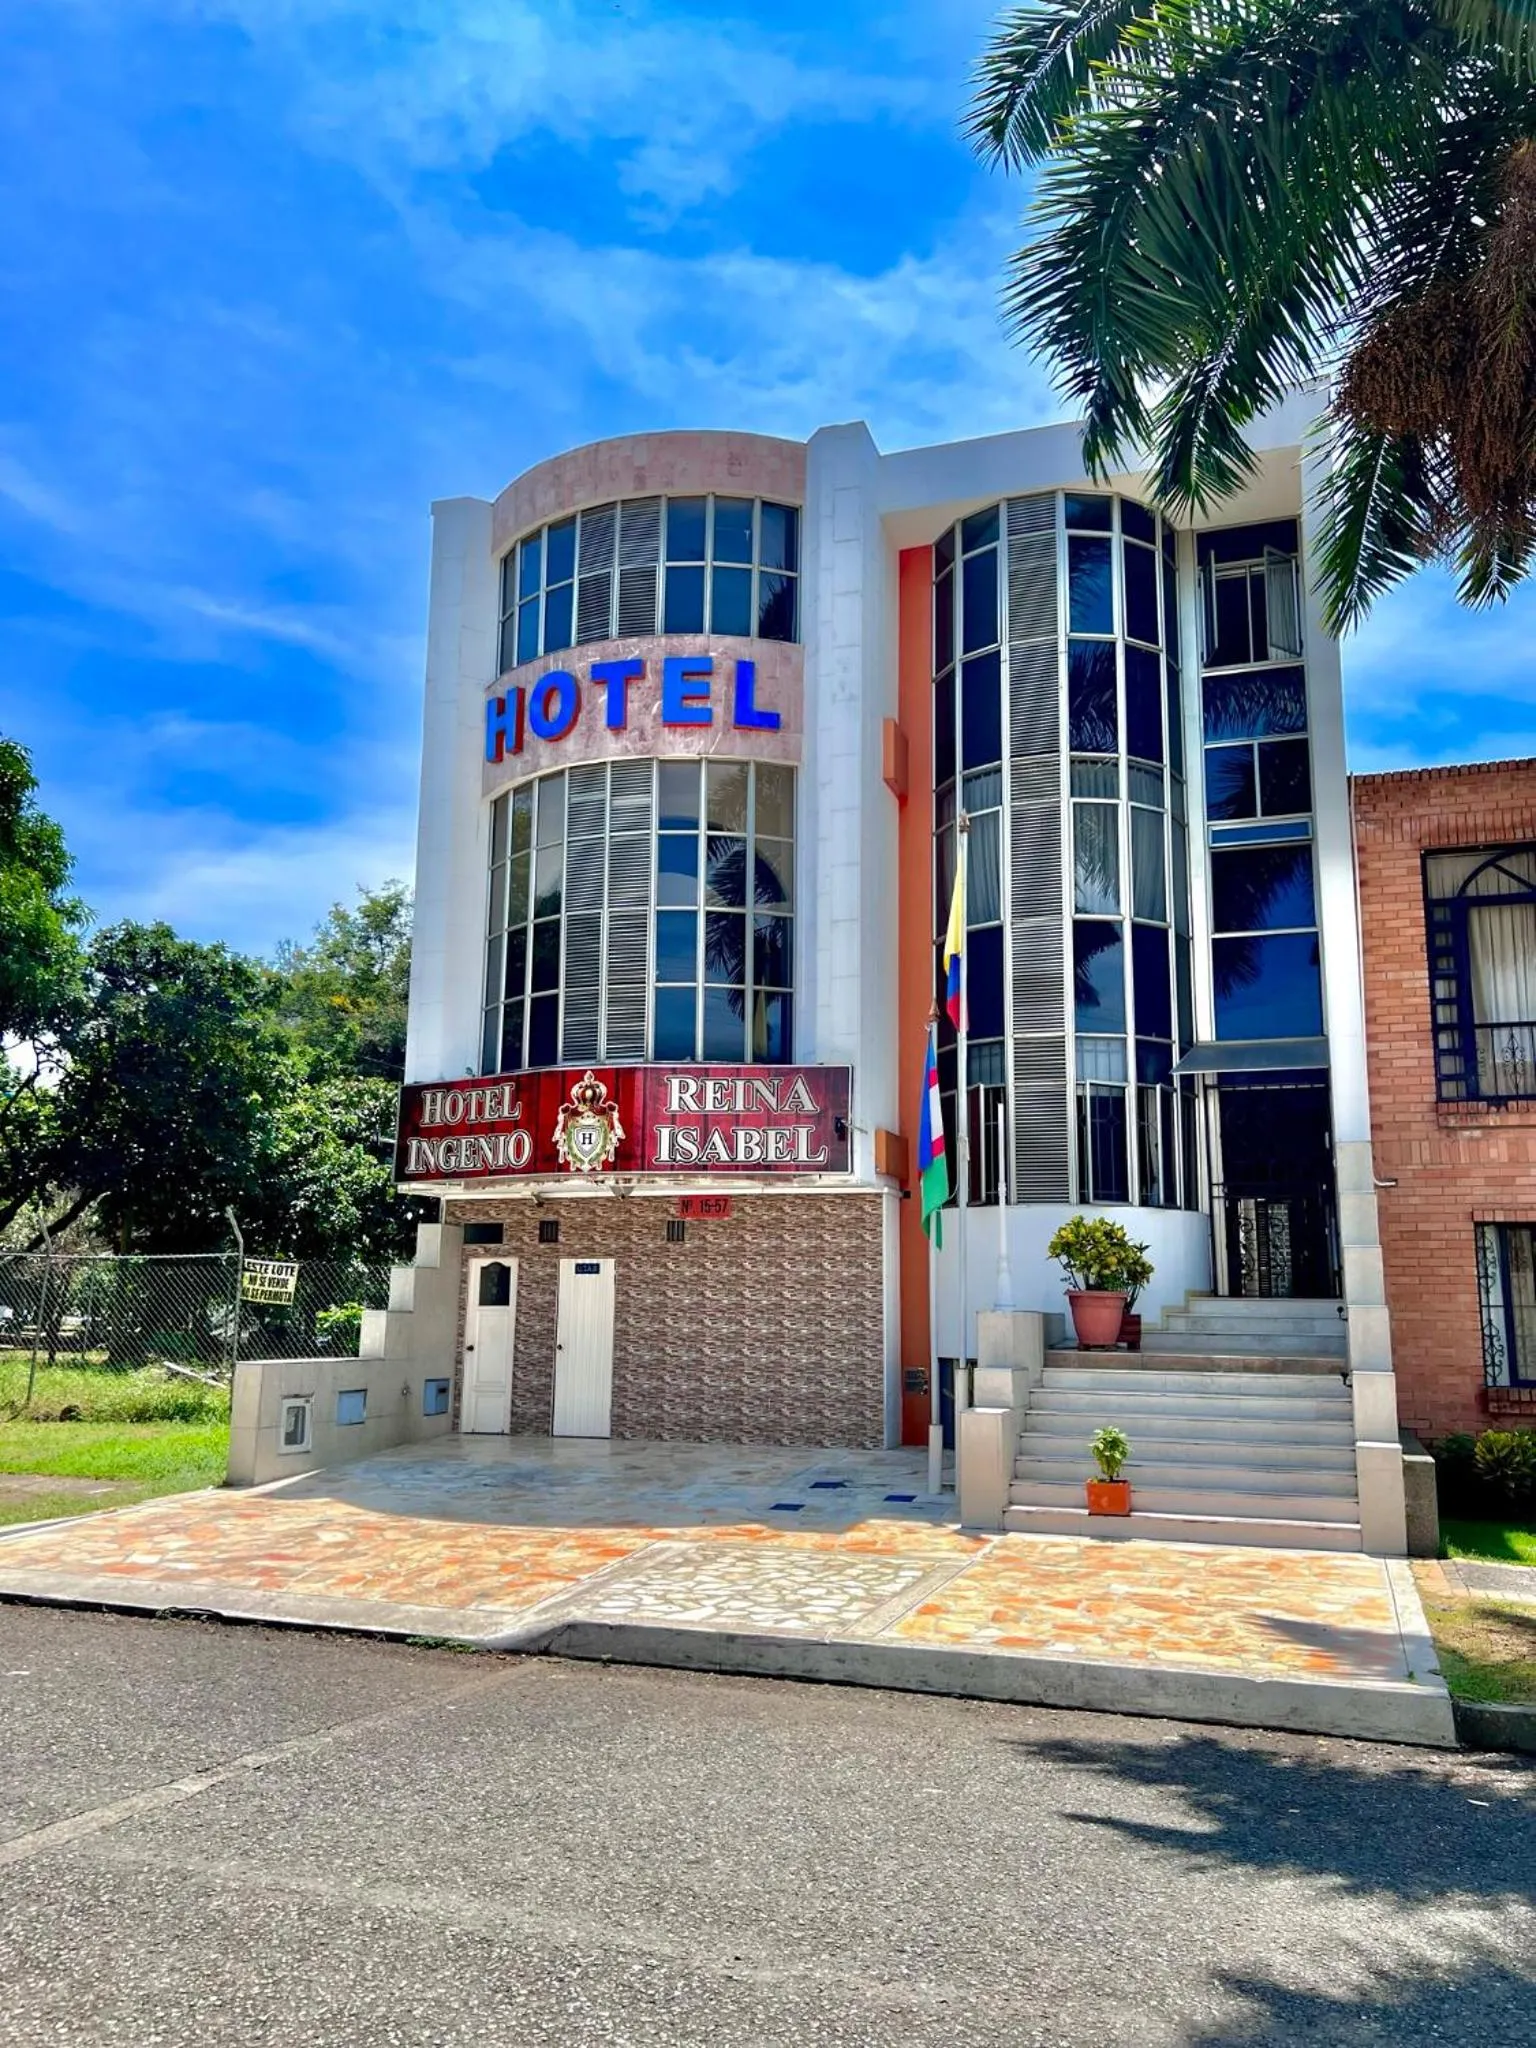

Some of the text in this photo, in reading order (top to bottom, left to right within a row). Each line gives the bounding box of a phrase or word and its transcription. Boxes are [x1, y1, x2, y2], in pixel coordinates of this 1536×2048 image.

[485, 656, 782, 763] HOTEL
[420, 1082, 522, 1127] HOTEL
[664, 1075, 819, 1114] REINA
[405, 1129, 532, 1173] INGENIO
[581, 1132, 594, 1145] H
[653, 1125, 828, 1164] ISABEL
[700, 1198, 729, 1213] 15-57
[246, 1261, 296, 1278] ESTE LOTE
[268, 1276, 289, 1290] VENDE
